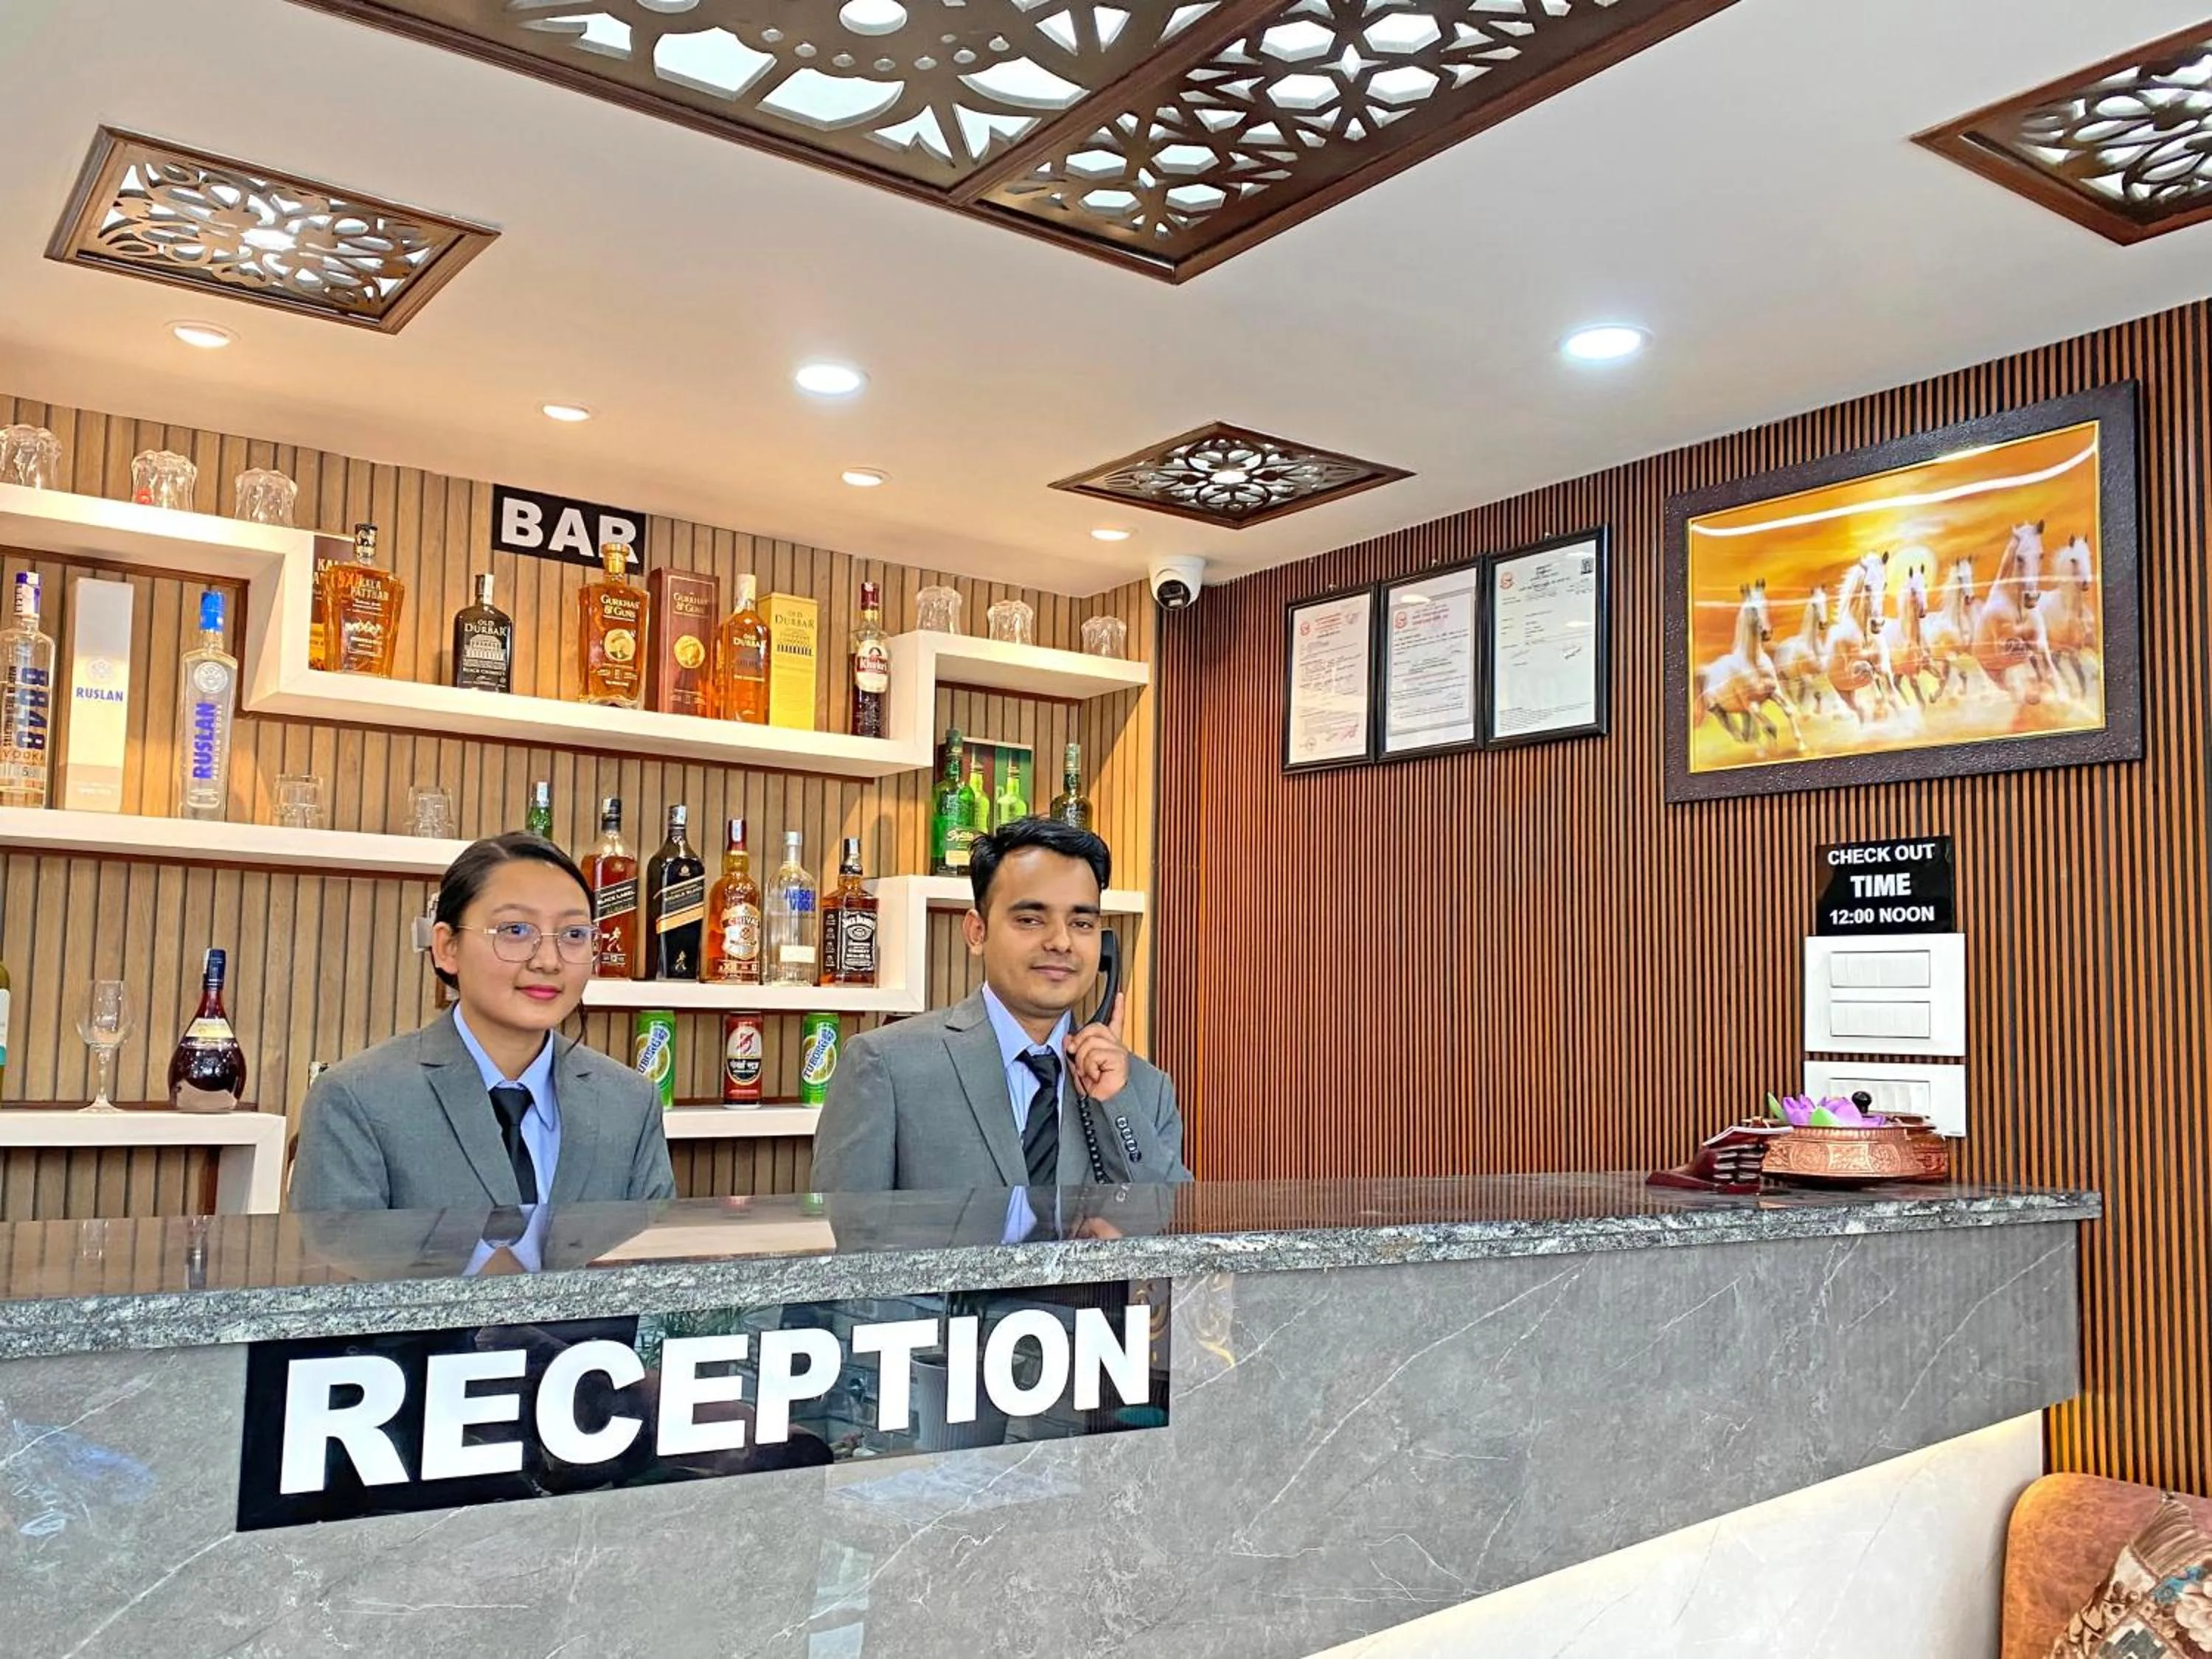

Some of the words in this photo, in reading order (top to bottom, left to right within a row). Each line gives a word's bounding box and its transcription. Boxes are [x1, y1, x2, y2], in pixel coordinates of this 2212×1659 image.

[501, 496, 639, 563] BAR
[465, 623, 507, 637] DURBAR
[76, 687, 123, 702] RUSLAN
[192, 702, 216, 779] RUSLAN
[1828, 846, 1891, 866] CHECK
[1895, 844, 1935, 860] OUT
[1850, 873, 1911, 898] TIME
[1829, 908, 1874, 925] 12:00
[1879, 906, 1935, 923] NOON
[639, 1035, 663, 1074] UBORG
[279, 1304, 1151, 1495] RECEPTION
